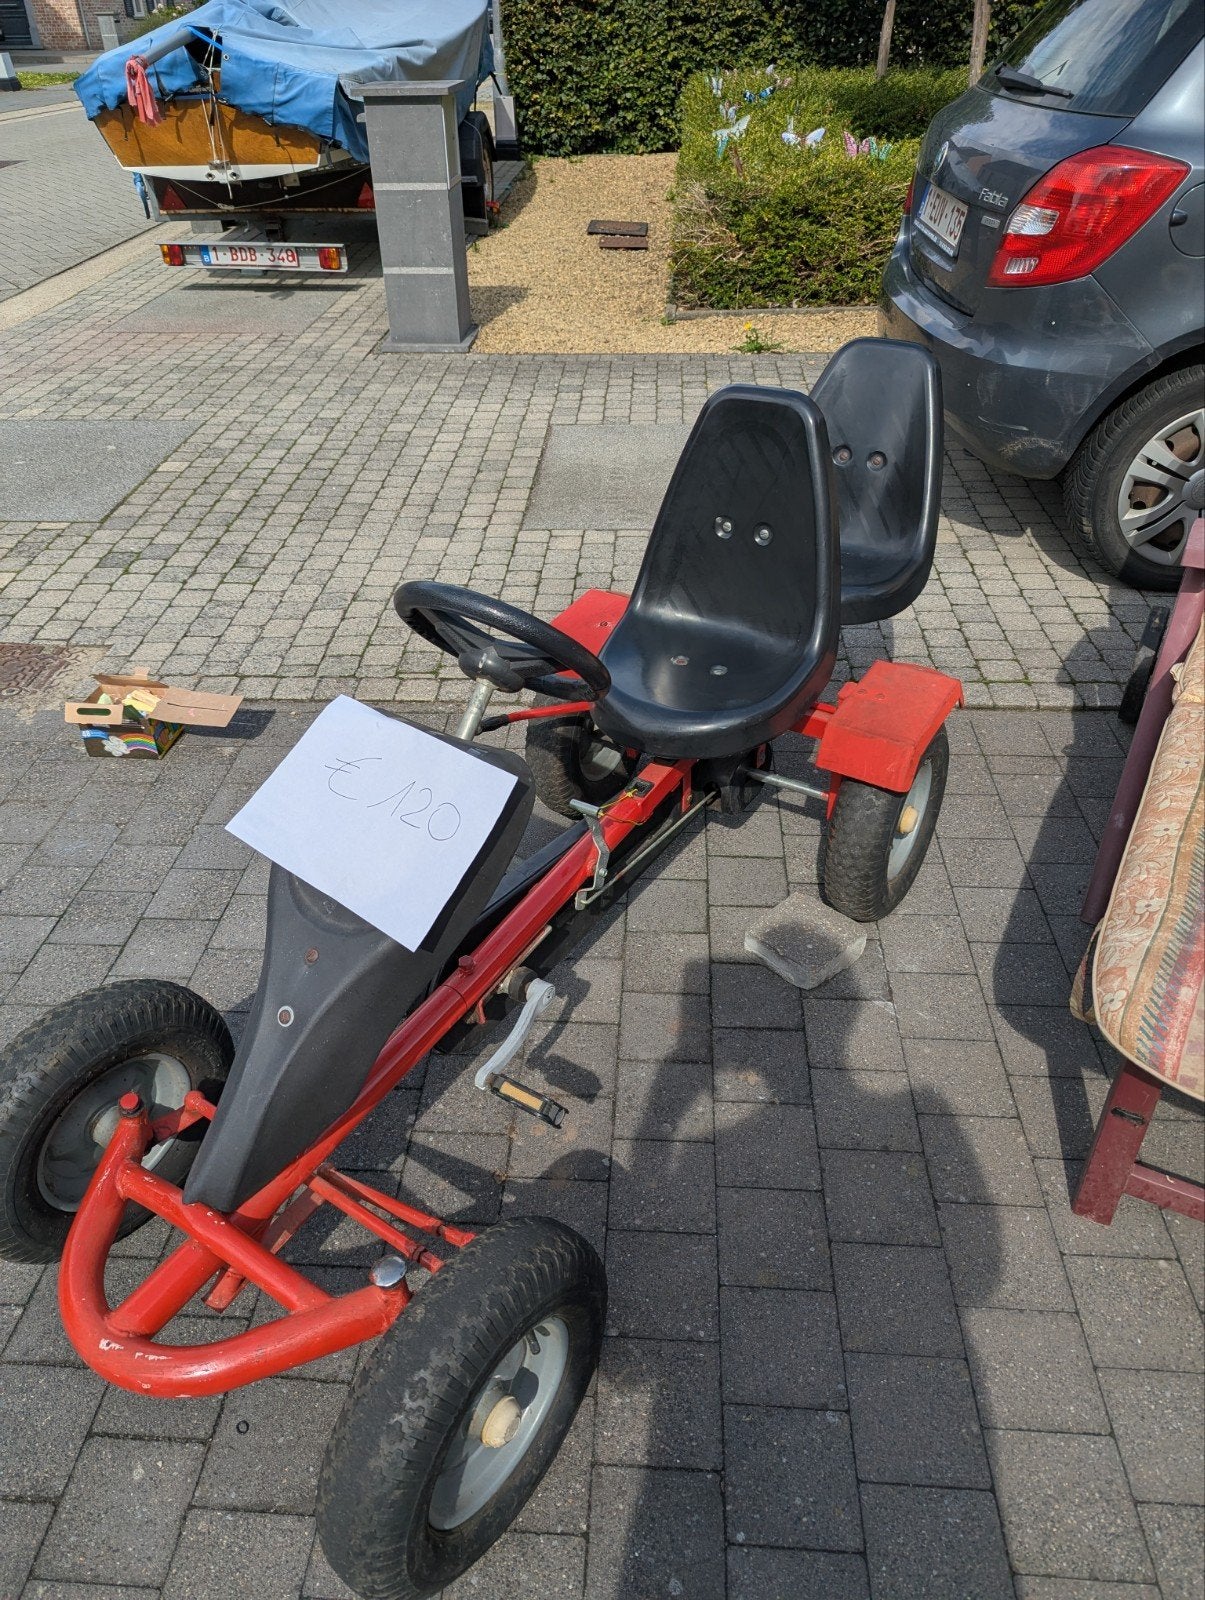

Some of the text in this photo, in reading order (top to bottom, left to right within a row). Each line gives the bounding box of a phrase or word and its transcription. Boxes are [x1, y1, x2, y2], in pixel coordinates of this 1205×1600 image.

[979, 188, 1009, 208] Fabia
[325, 757, 461, 841] € 120
